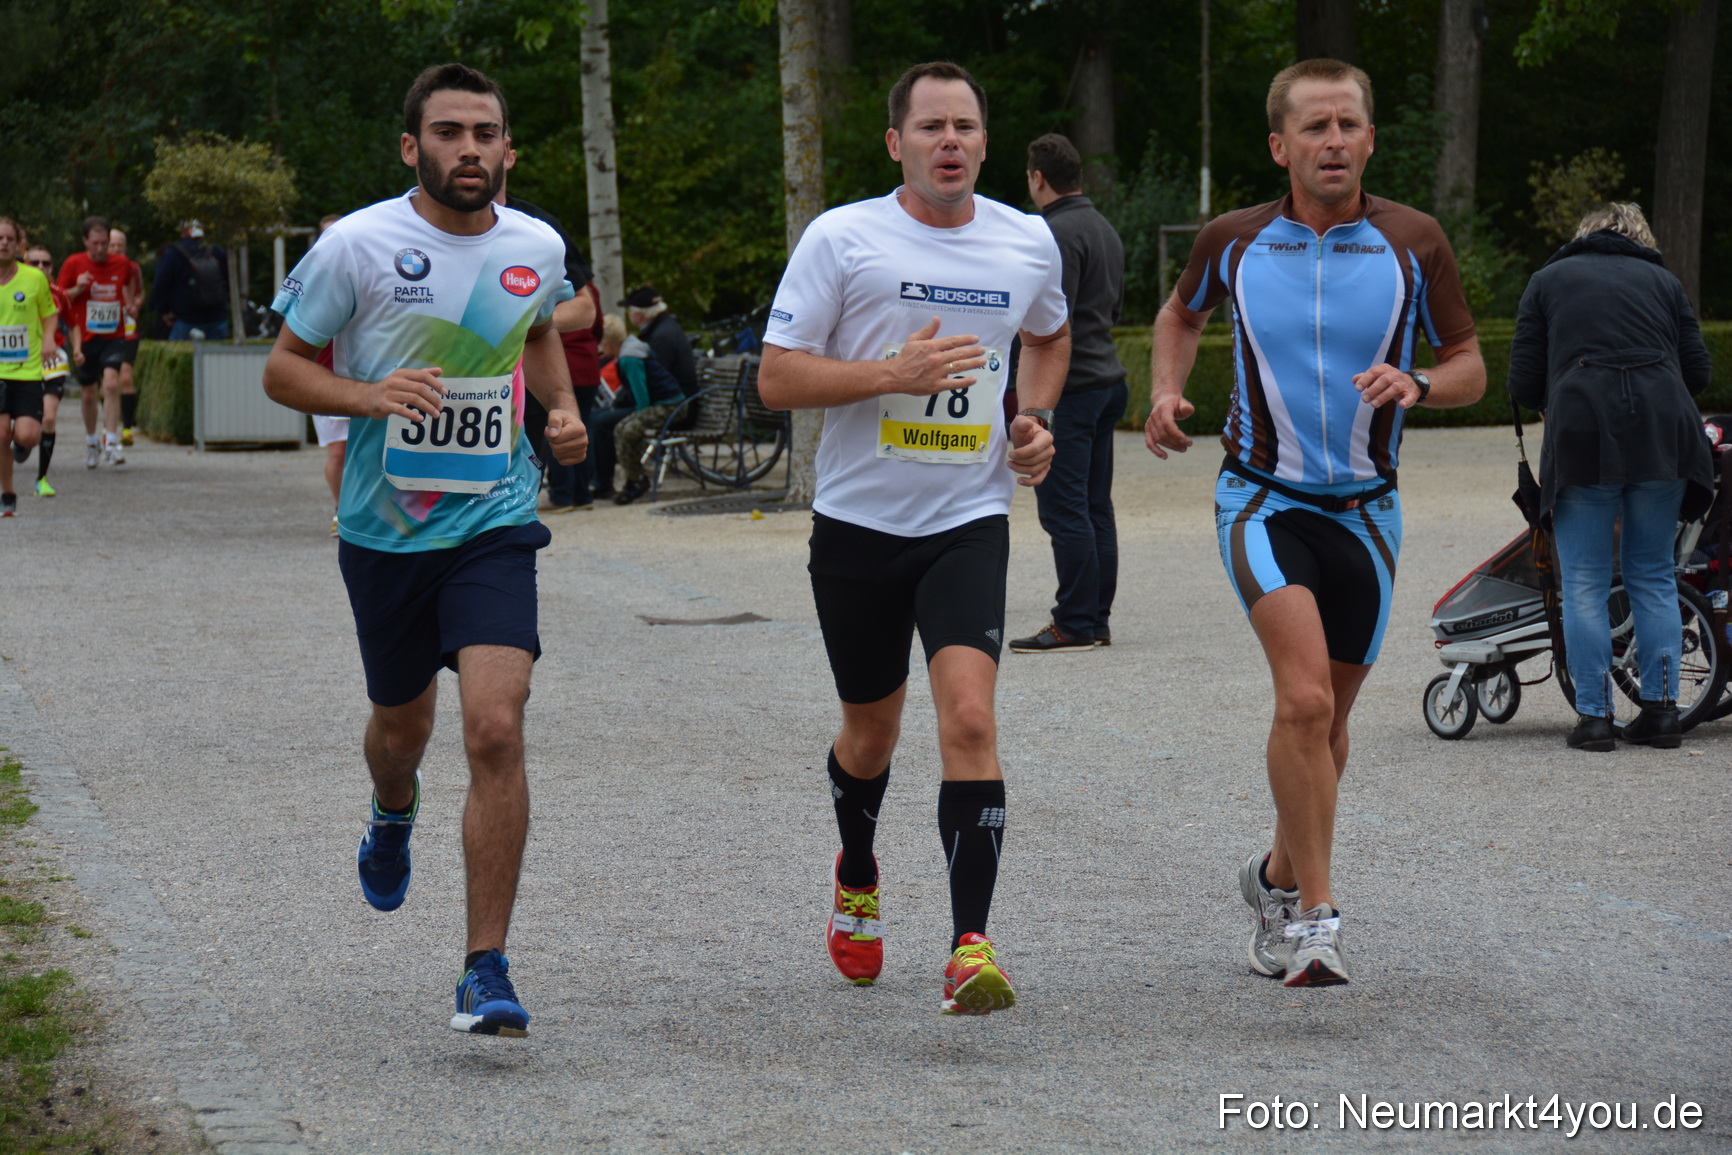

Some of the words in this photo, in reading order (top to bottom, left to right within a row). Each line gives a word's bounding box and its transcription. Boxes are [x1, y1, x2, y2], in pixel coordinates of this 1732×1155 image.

[506, 273, 537, 288] Hervis
[394, 287, 434, 297] PARTL
[934, 289, 1007, 305] BÜSCHEL
[394, 296, 434, 304] Neumarkt
[441, 389, 498, 401] Neumarkt
[401, 403, 503, 449] 3086
[903, 428, 977, 451] Wolfgang
[1456, 610, 1514, 631] chariot
[976, 820, 1003, 829] cep
